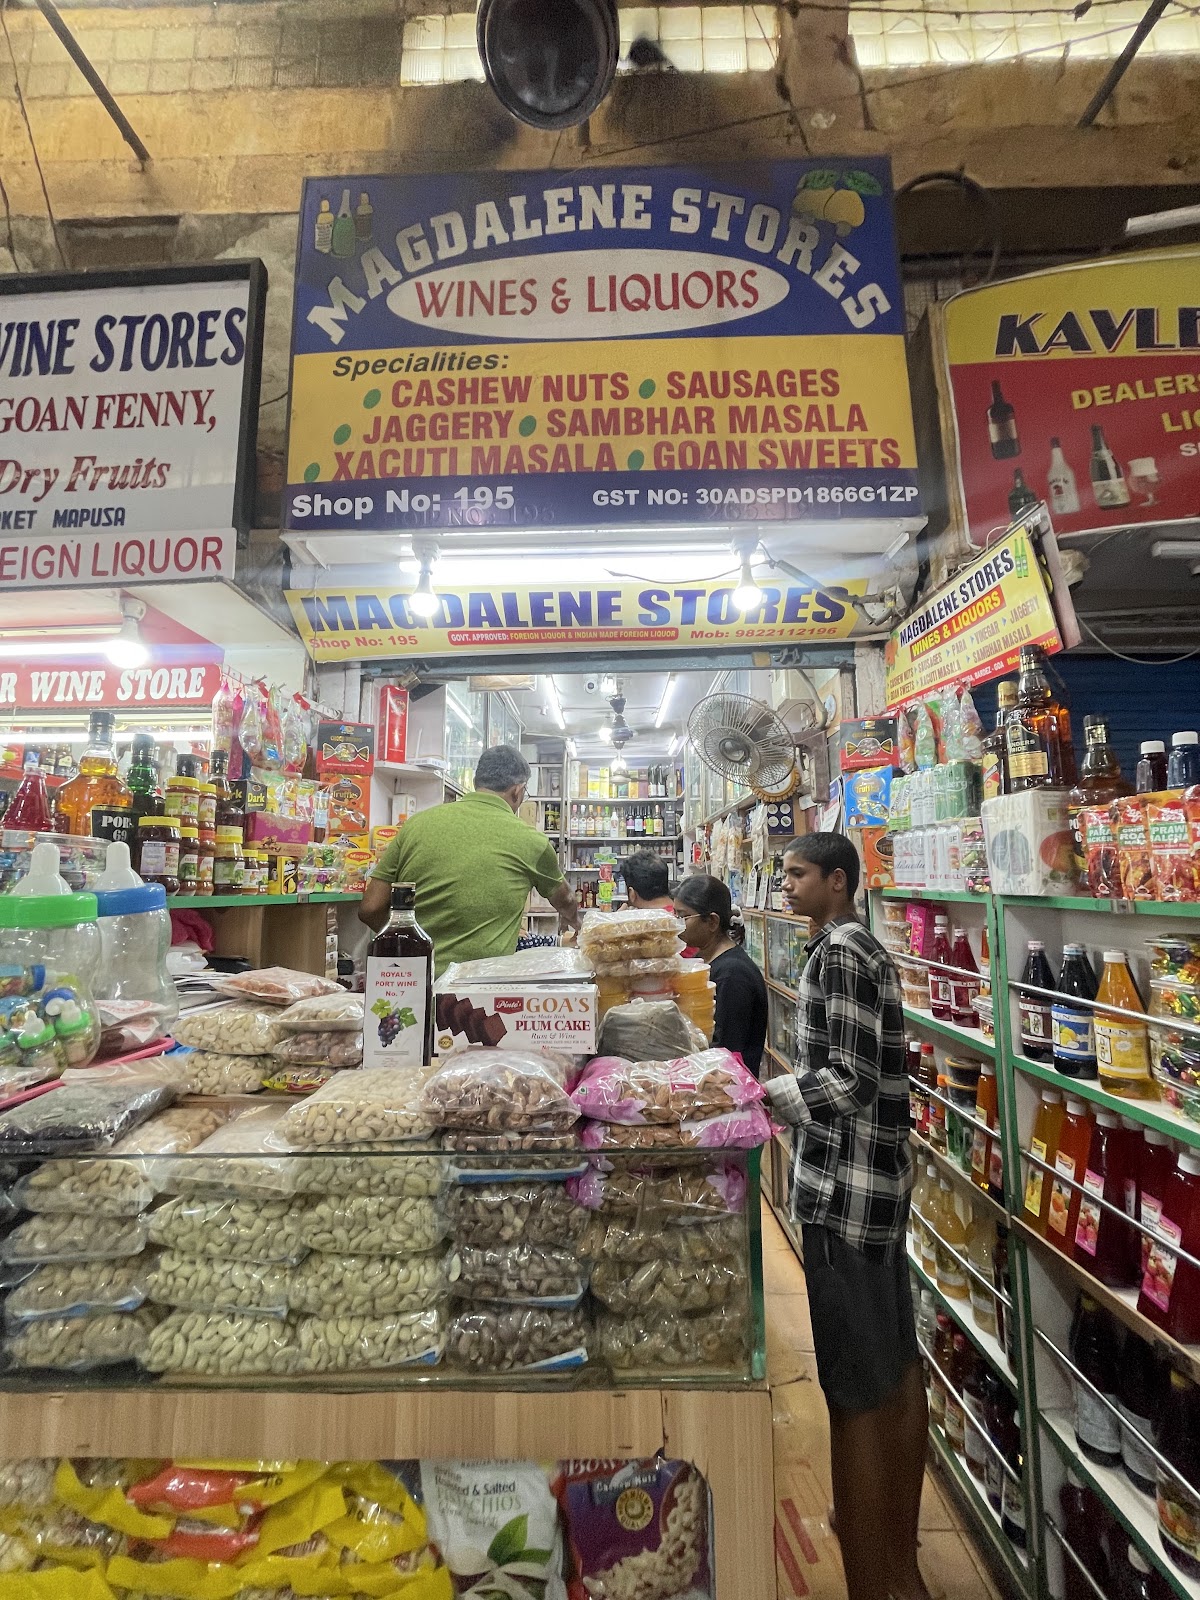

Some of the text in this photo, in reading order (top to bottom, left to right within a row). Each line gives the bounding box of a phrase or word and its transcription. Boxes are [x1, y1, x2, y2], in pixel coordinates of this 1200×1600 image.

[306, 184, 893, 346] MAGDALENE STORES
[415, 269, 761, 319] WINES & LIQUORS
[90, 307, 248, 374] STORES
[333, 352, 509, 381] Specialities:
[667, 368, 841, 399] SAUSAGES
[391, 371, 630, 408] CASHEW NUTS
[1071, 373, 1200, 410] DEALER
[94, 388, 217, 433] FENNY,
[362, 409, 515, 444] JAGGERY
[546, 403, 869, 438] SAMBHAR MASALA
[332, 442, 617, 482] XACUTI MASALA
[653, 438, 901, 471] GOAN SWEETS
[64, 455, 172, 493] Fruits
[291, 494, 374, 520] Shop
[386, 489, 441, 513] No:
[454, 485, 515, 510] 195
[592, 486, 919, 506] GST NO: 30ADSPD1866G1ZP
[52, 506, 126, 528] MAPUSA
[91, 536, 223, 577] LIQUOR
[300, 586, 850, 632] MAGDALENE STORES
[900, 548, 1015, 648] MAGDALENE STORES
[451, 630, 676, 642] GOVT. APPROVED: FOREIGN LIQUOR & INDIAN MADE FOREIGN LIQUOR
[690, 629, 730, 639] Mob:
[911, 591, 1001, 657] WINES & LIQUORS
[308, 635, 418, 650] Shop No: 195
[30, 670, 106, 702] WINE
[116, 667, 206, 700] STORE
[247, 792, 265, 803] Dark
[113, 829, 127, 841] 69
[1152, 824, 1188, 835] PRAW
[526, 997, 590, 1013] GOA'S
[515, 1020, 591, 1031] PLUM CAKE
[531, 1032, 548, 1040] Rum
[472, 1484, 480, 1497] &
[483, 1480, 516, 1496] Salted
